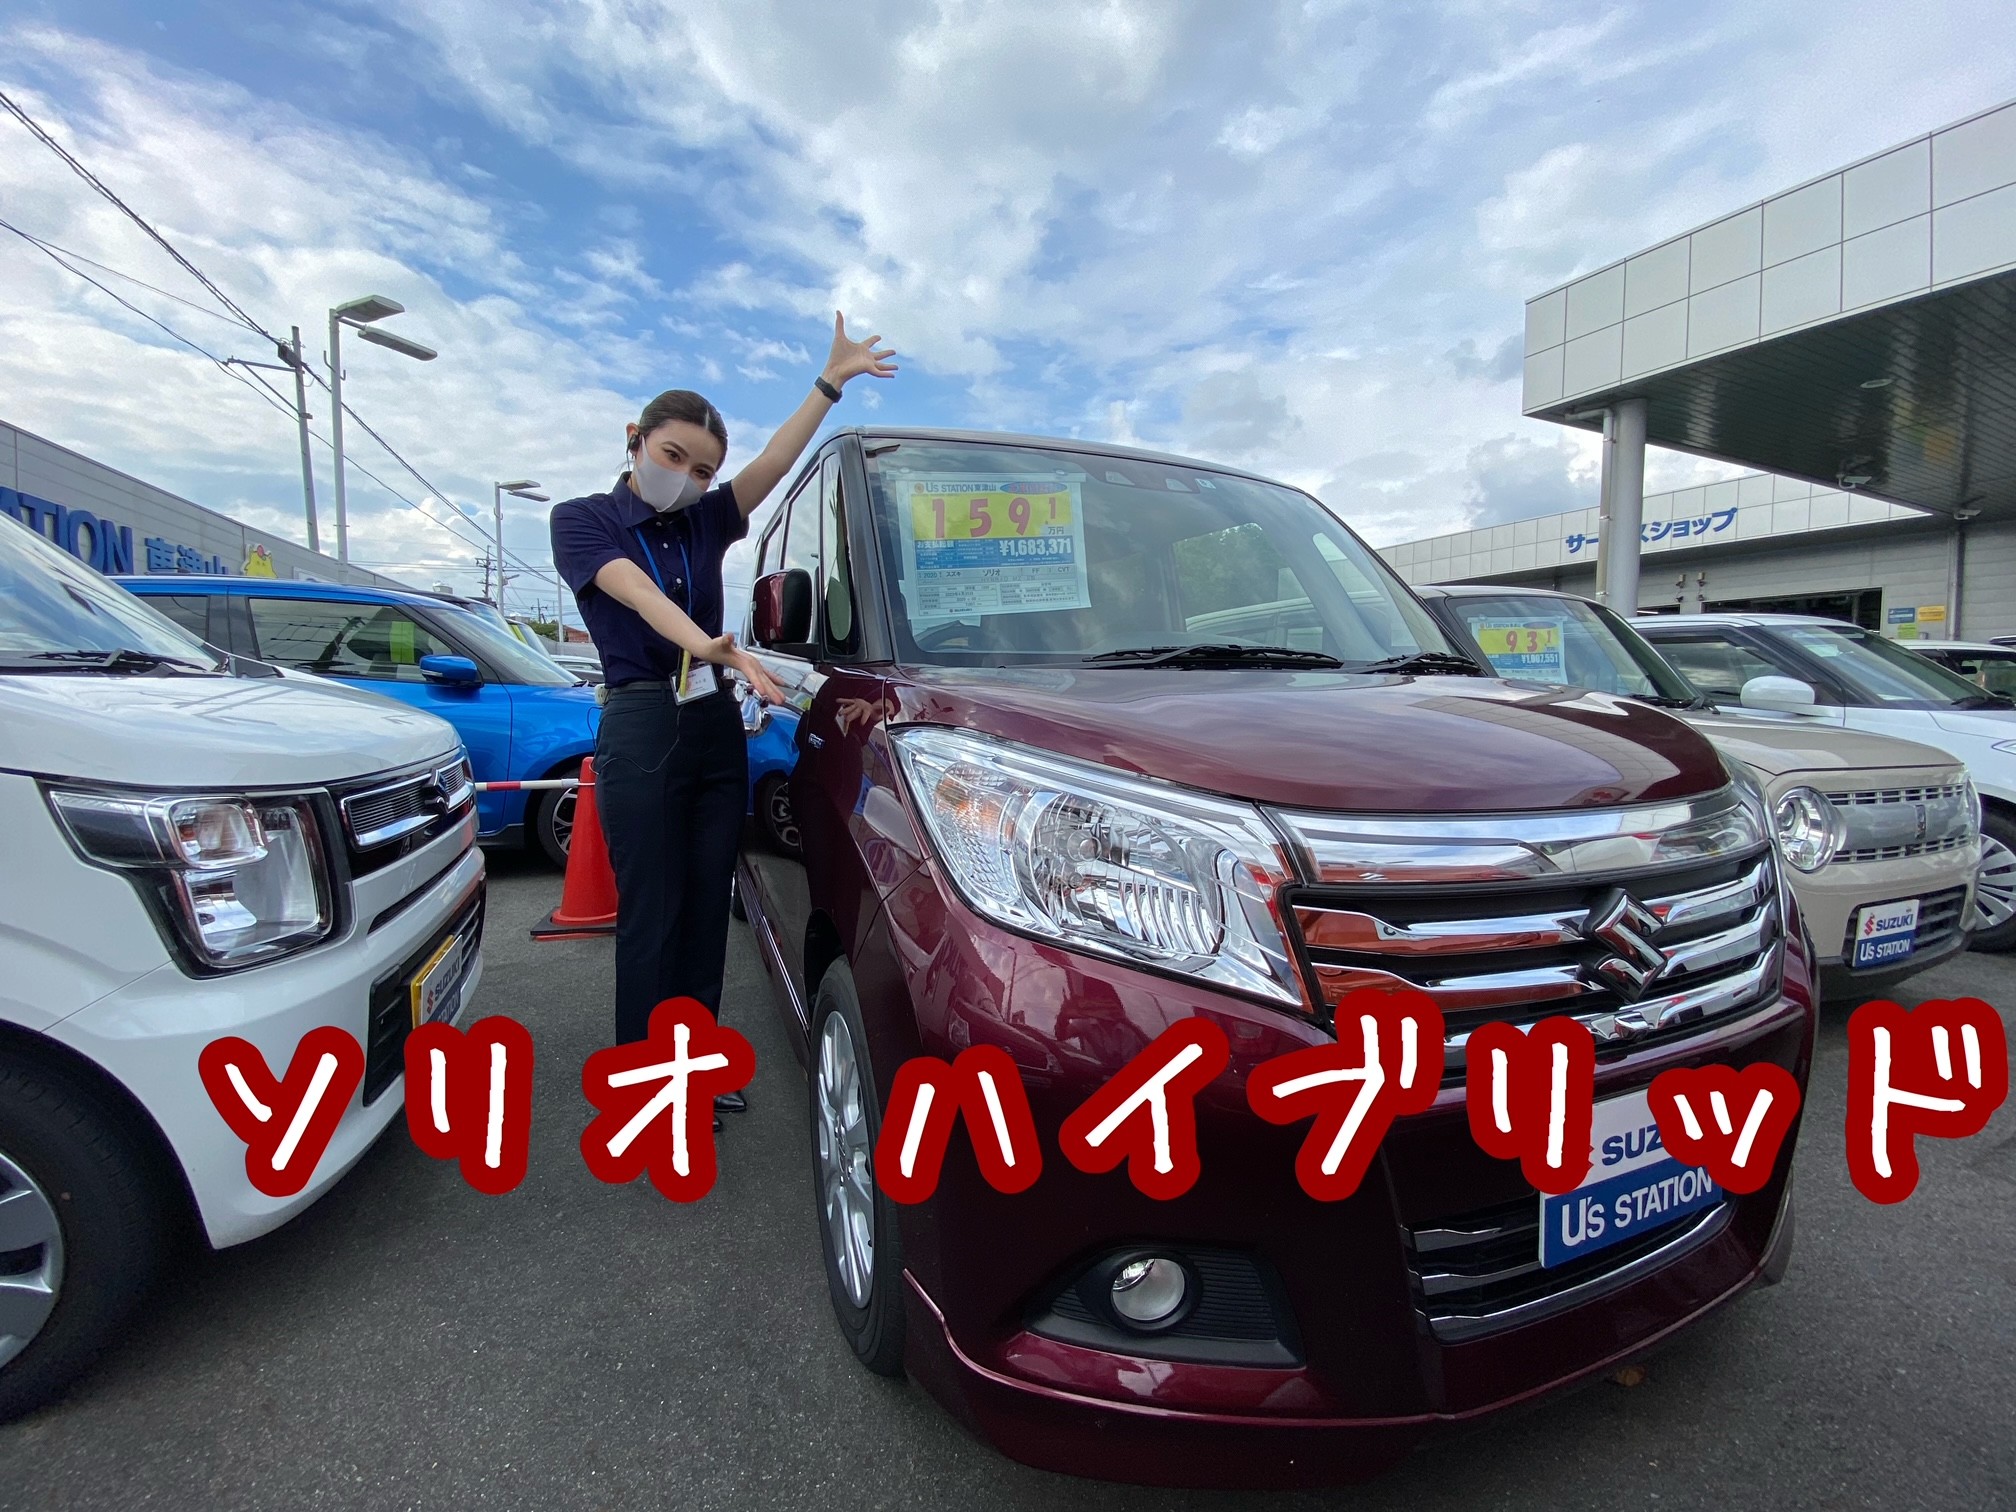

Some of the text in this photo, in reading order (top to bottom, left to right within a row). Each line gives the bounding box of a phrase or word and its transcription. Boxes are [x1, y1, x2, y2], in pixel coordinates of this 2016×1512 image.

[1048, 526, 1064, 535] 万円
[999, 538, 1072, 557] ¥1,683,371
[1875, 913, 1914, 932] SUZUKI
[1876, 938, 1911, 958] STATION
[1614, 1166, 1713, 1229] STATION
